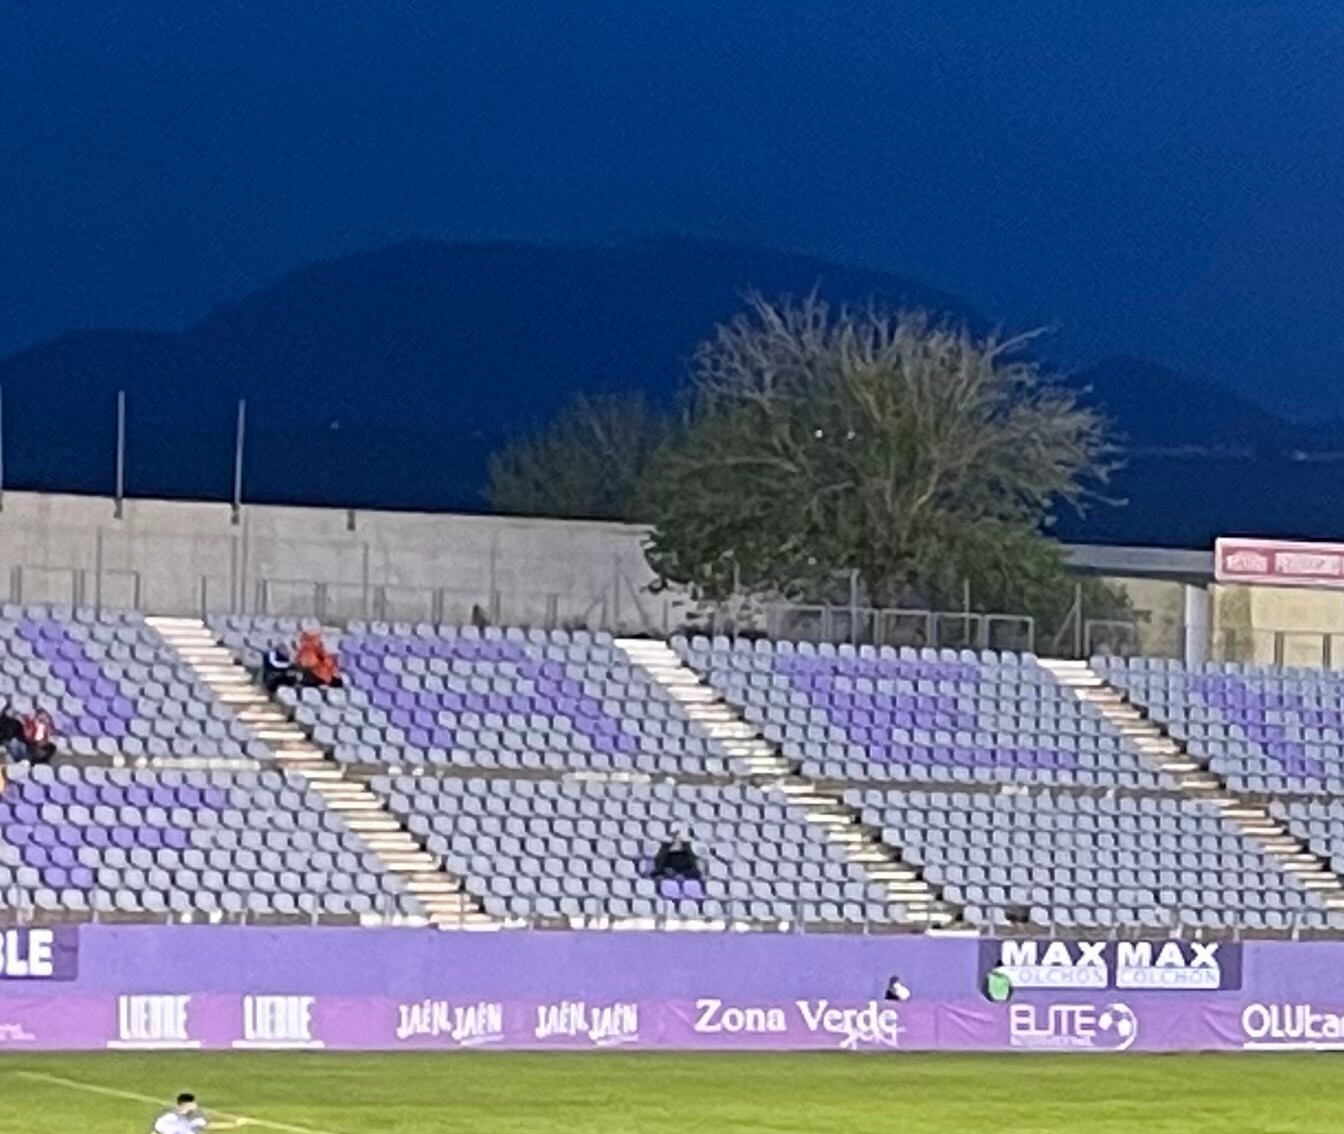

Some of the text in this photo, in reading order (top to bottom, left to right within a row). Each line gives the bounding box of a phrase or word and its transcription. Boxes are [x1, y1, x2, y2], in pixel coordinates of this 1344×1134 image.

[0, 929, 54, 976] LE
[1002, 941, 1106, 967] MAX
[1117, 941, 1219, 968] MAX
[693, 998, 899, 1036] Zona Verde
[1010, 1004, 1097, 1036] ELITE
